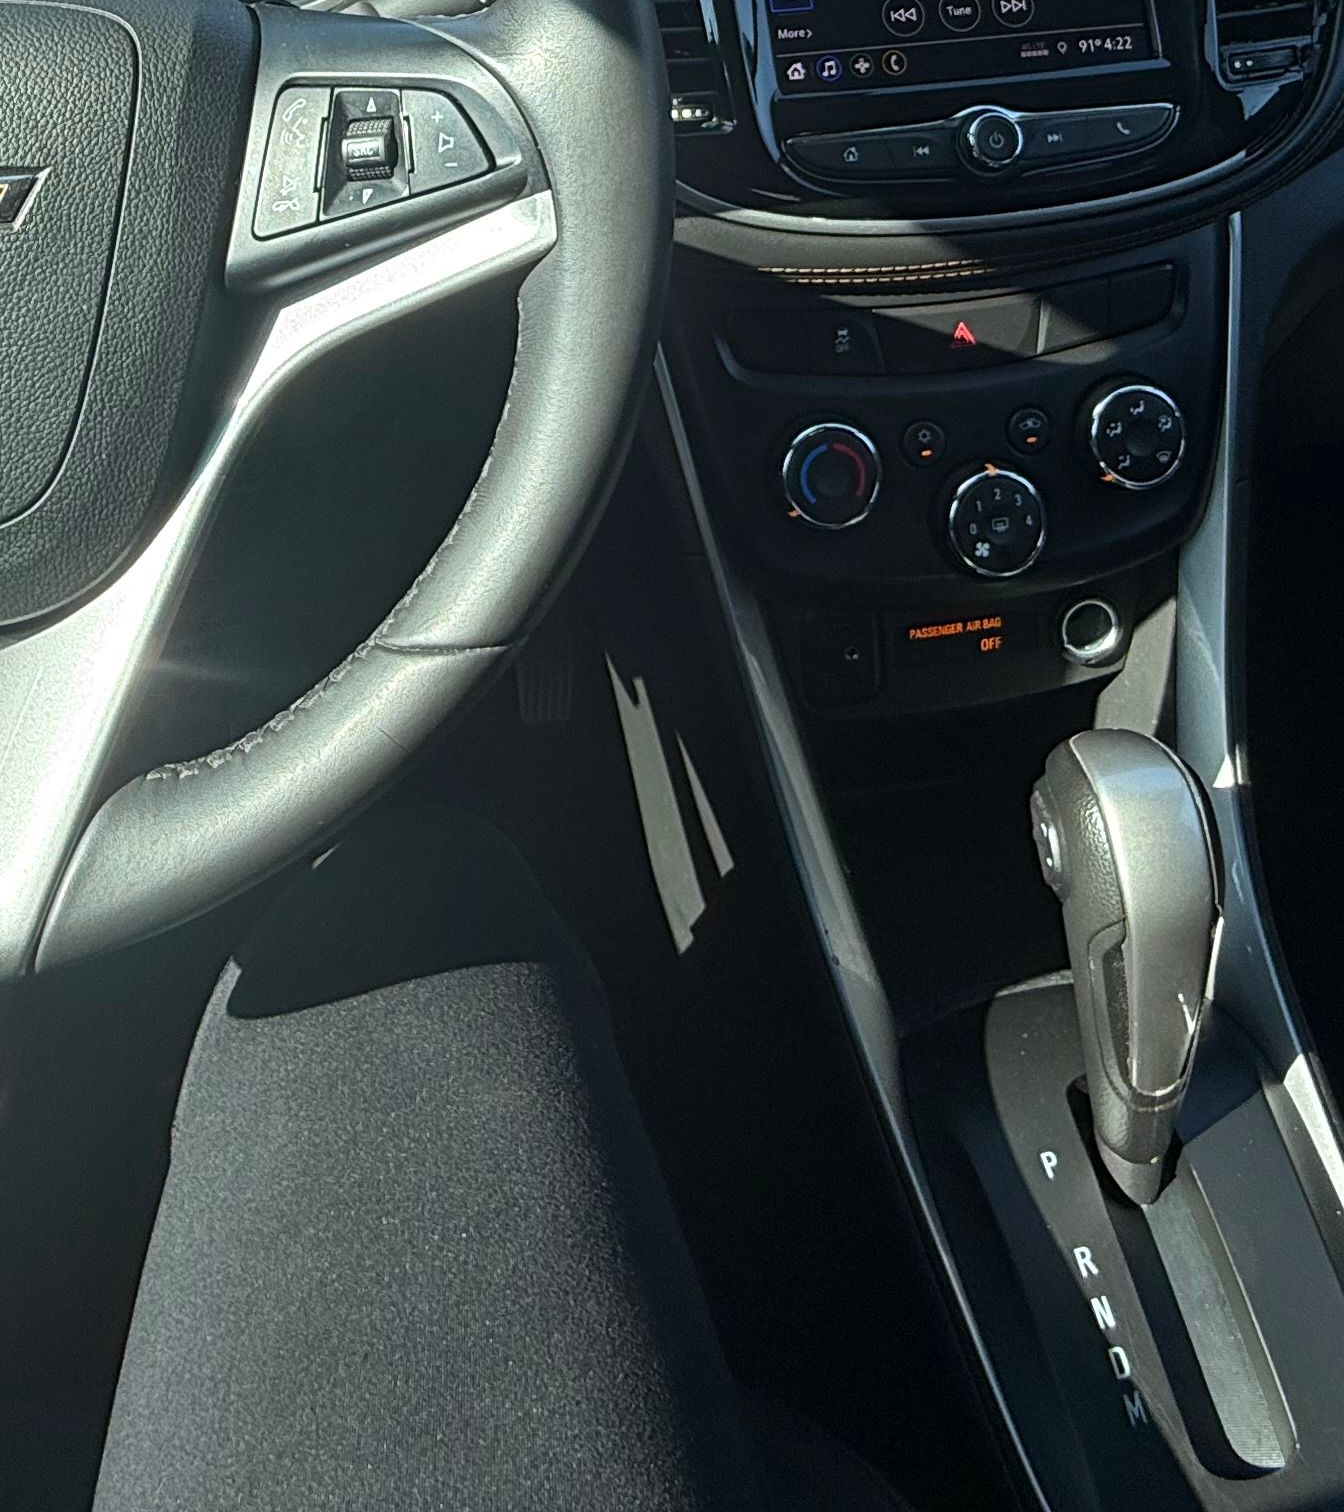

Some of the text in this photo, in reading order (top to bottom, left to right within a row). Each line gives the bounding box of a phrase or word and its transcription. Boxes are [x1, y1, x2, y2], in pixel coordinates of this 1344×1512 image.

[946, 4, 972, 17] Tune
[777, 28, 806, 40] More
[1103, 35, 1133, 51] 4:22
[994, 488, 1001, 500] 2
[1015, 494, 1022, 506] 3
[976, 500, 982, 512] 1
[1025, 514, 1033, 526] 4
[969, 523, 978, 535] 0
[909, 616, 1002, 639] PASSENGER AIR BAG
[980, 636, 1002, 651] OFF
[1039, 1150, 1058, 1180] P
[1073, 1245, 1099, 1279] R
[1090, 1295, 1117, 1330] N
[1108, 1345, 1131, 1380] D
[1123, 1390, 1148, 1427] M
